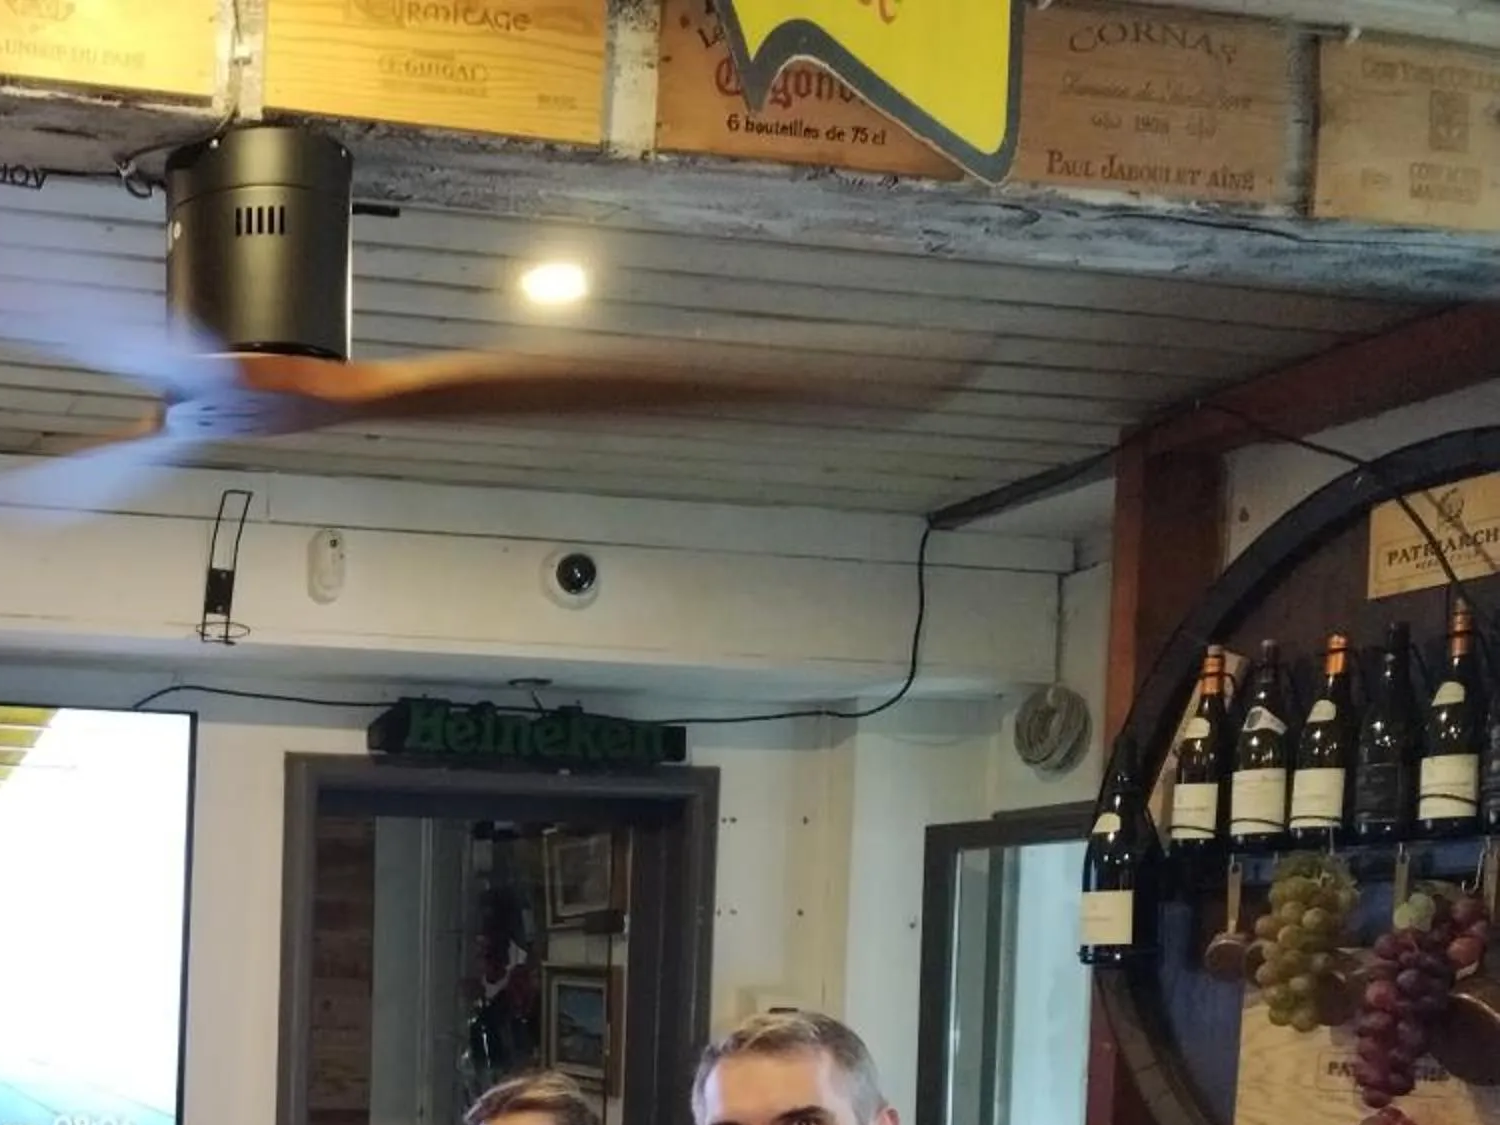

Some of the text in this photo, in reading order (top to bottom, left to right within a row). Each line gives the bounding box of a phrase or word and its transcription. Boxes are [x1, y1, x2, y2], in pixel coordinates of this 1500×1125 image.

[727, 113, 888, 146] 6 bouteilles de 75 cl
[1046, 149, 1095, 177] PAUL
[404, 702, 663, 757] Heineken
